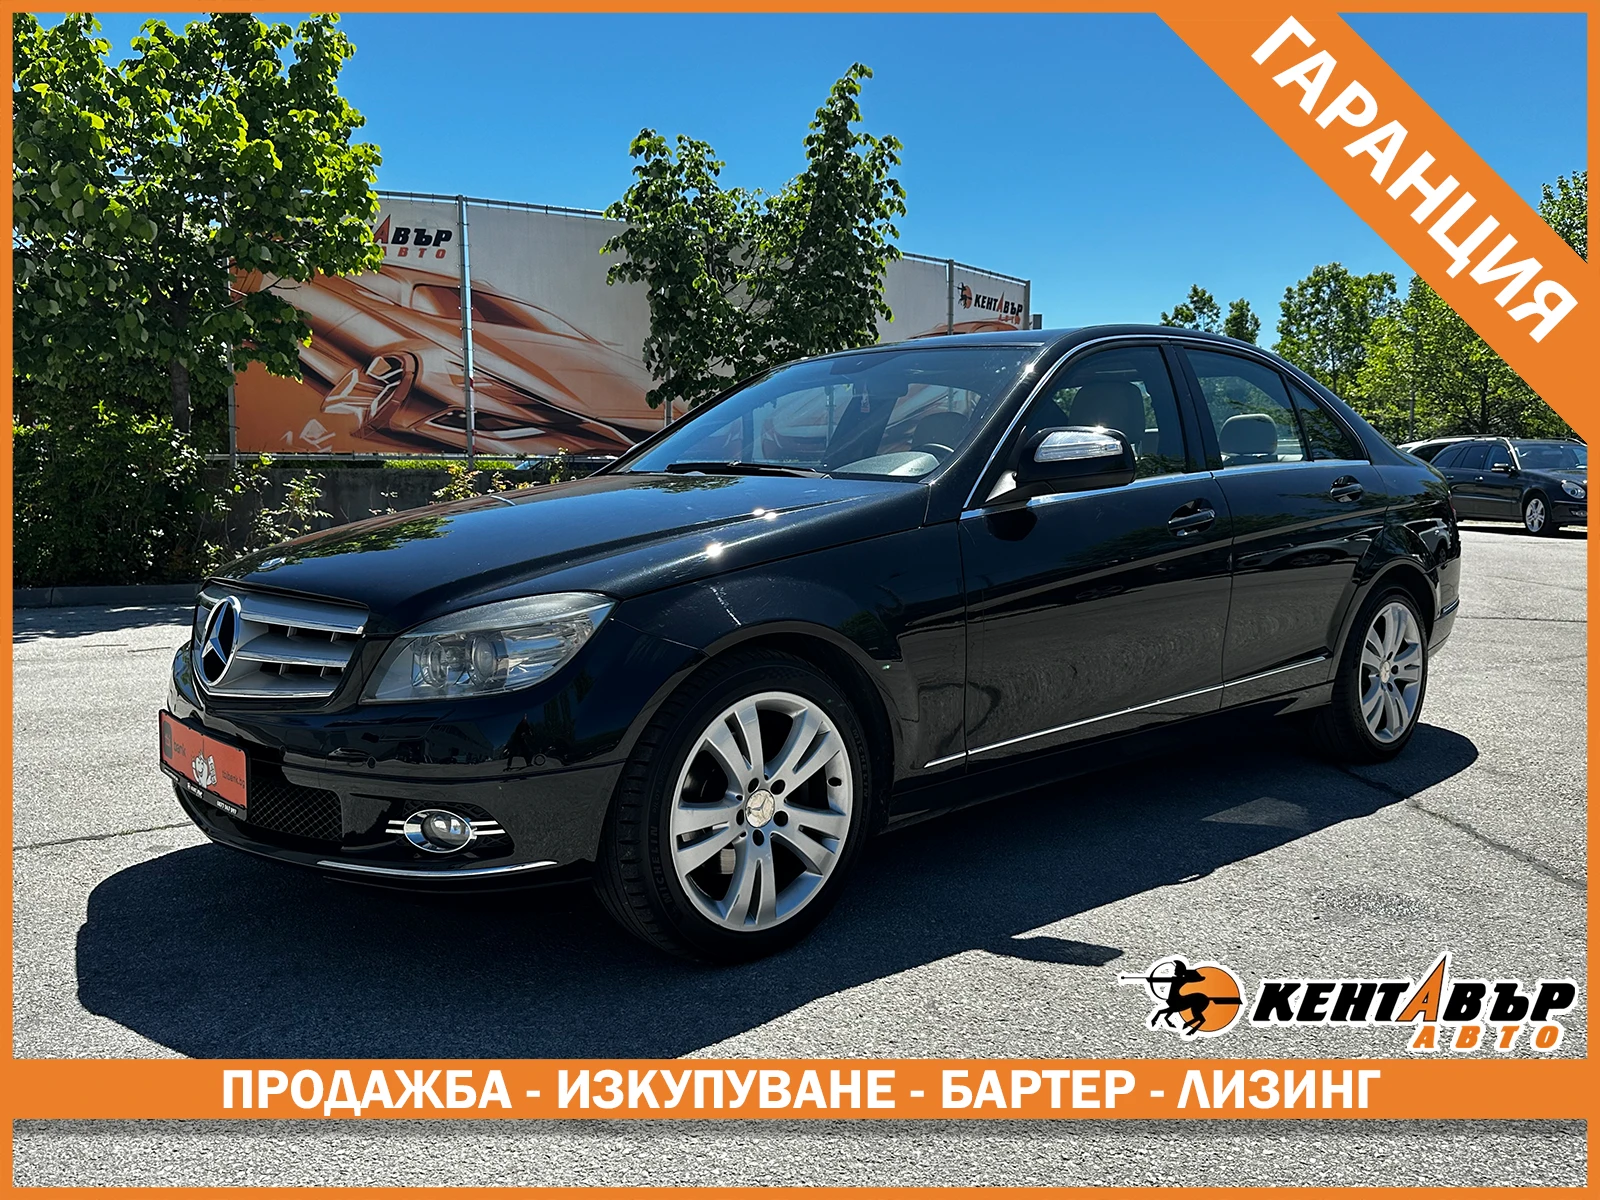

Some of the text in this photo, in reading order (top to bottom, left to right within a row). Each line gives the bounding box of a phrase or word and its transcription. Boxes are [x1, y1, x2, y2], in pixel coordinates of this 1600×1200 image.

[371, 213, 453, 247] АВЪР
[974, 291, 1023, 316] КЕНТАВЪР
[649, 825, 672, 904] MICHELIN
